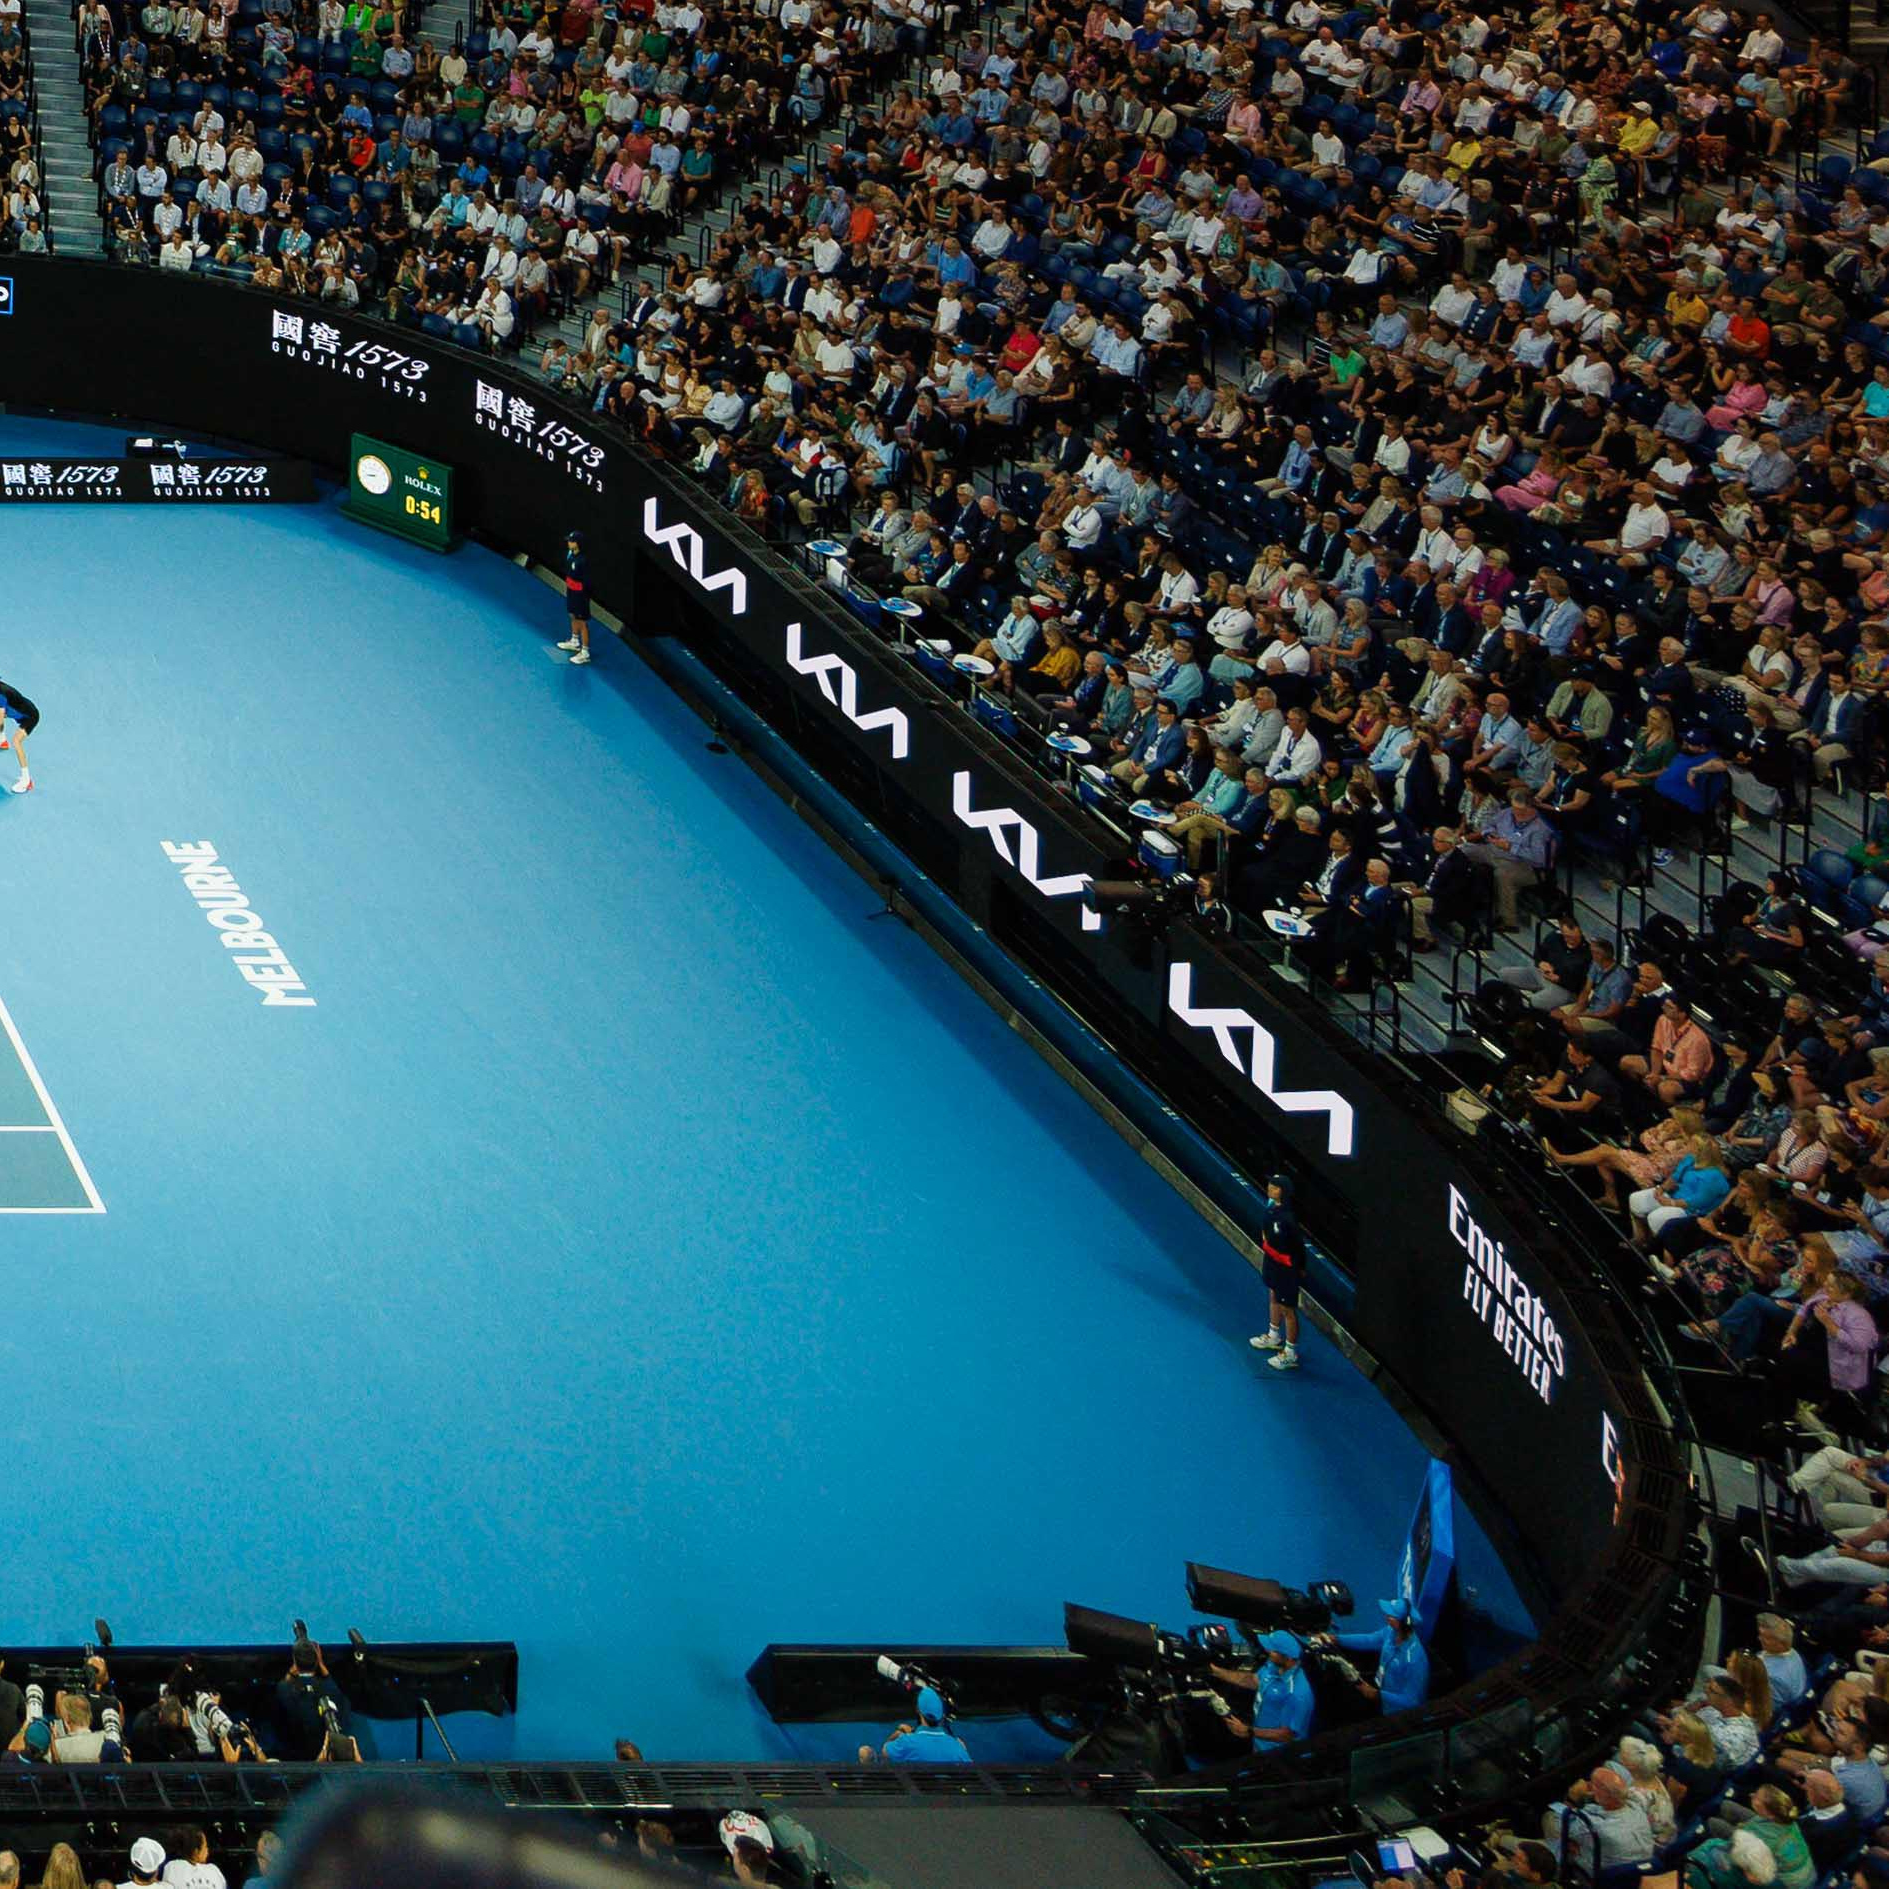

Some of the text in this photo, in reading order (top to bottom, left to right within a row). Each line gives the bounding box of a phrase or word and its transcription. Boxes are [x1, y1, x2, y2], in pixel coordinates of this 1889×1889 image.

[272, 341, 428, 403] GUOJIAO 1573
[404, 474, 442, 497] ROLEX
[475, 412, 603, 493] GUOJIAO 1573
[87, 487, 122, 497] 1573
[405, 495, 441, 524] 0:54
[160, 840, 318, 1006] MELBOURNE
[1449, 1182, 1565, 1378] Emirates
[1463, 1264, 1551, 1406] FLY BETTER
